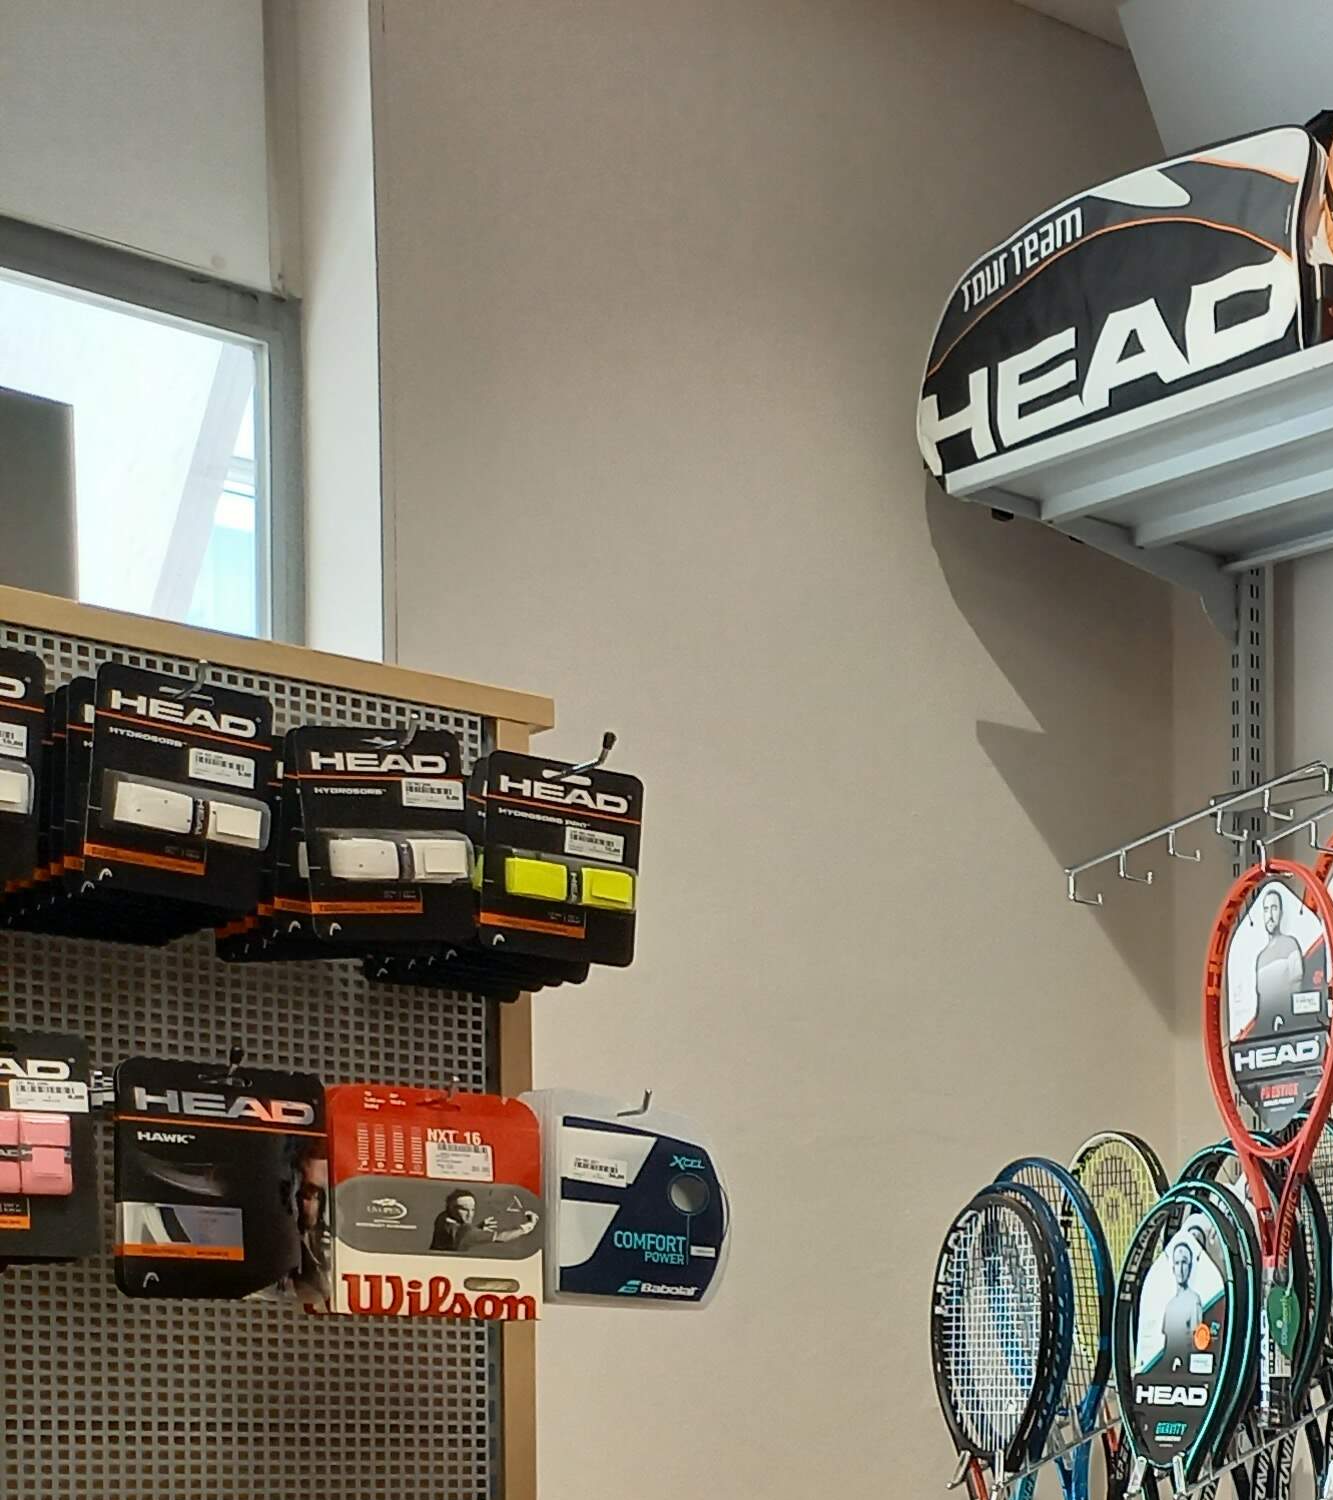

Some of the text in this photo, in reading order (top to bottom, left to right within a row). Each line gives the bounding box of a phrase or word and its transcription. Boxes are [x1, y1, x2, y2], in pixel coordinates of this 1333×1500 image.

[918, 251, 1300, 478] HEAD
[111, 689, 257, 738] HEAD
[310, 750, 449, 774] HEAD
[500, 774, 628, 815] HEAD
[1235, 1041, 1320, 1072] HEAD
[1260, 1080, 1299, 1099] PRESTIGE
[133, 1086, 315, 1126] HEAD
[137, 1130, 189, 1145] HAWK
[427, 1127, 482, 1146] NXT 16
[613, 1229, 687, 1256] COMFORT
[644, 1251, 685, 1266] POWER
[341, 1272, 538, 1322] Wilson
[1135, 1384, 1209, 1408] HEAD
